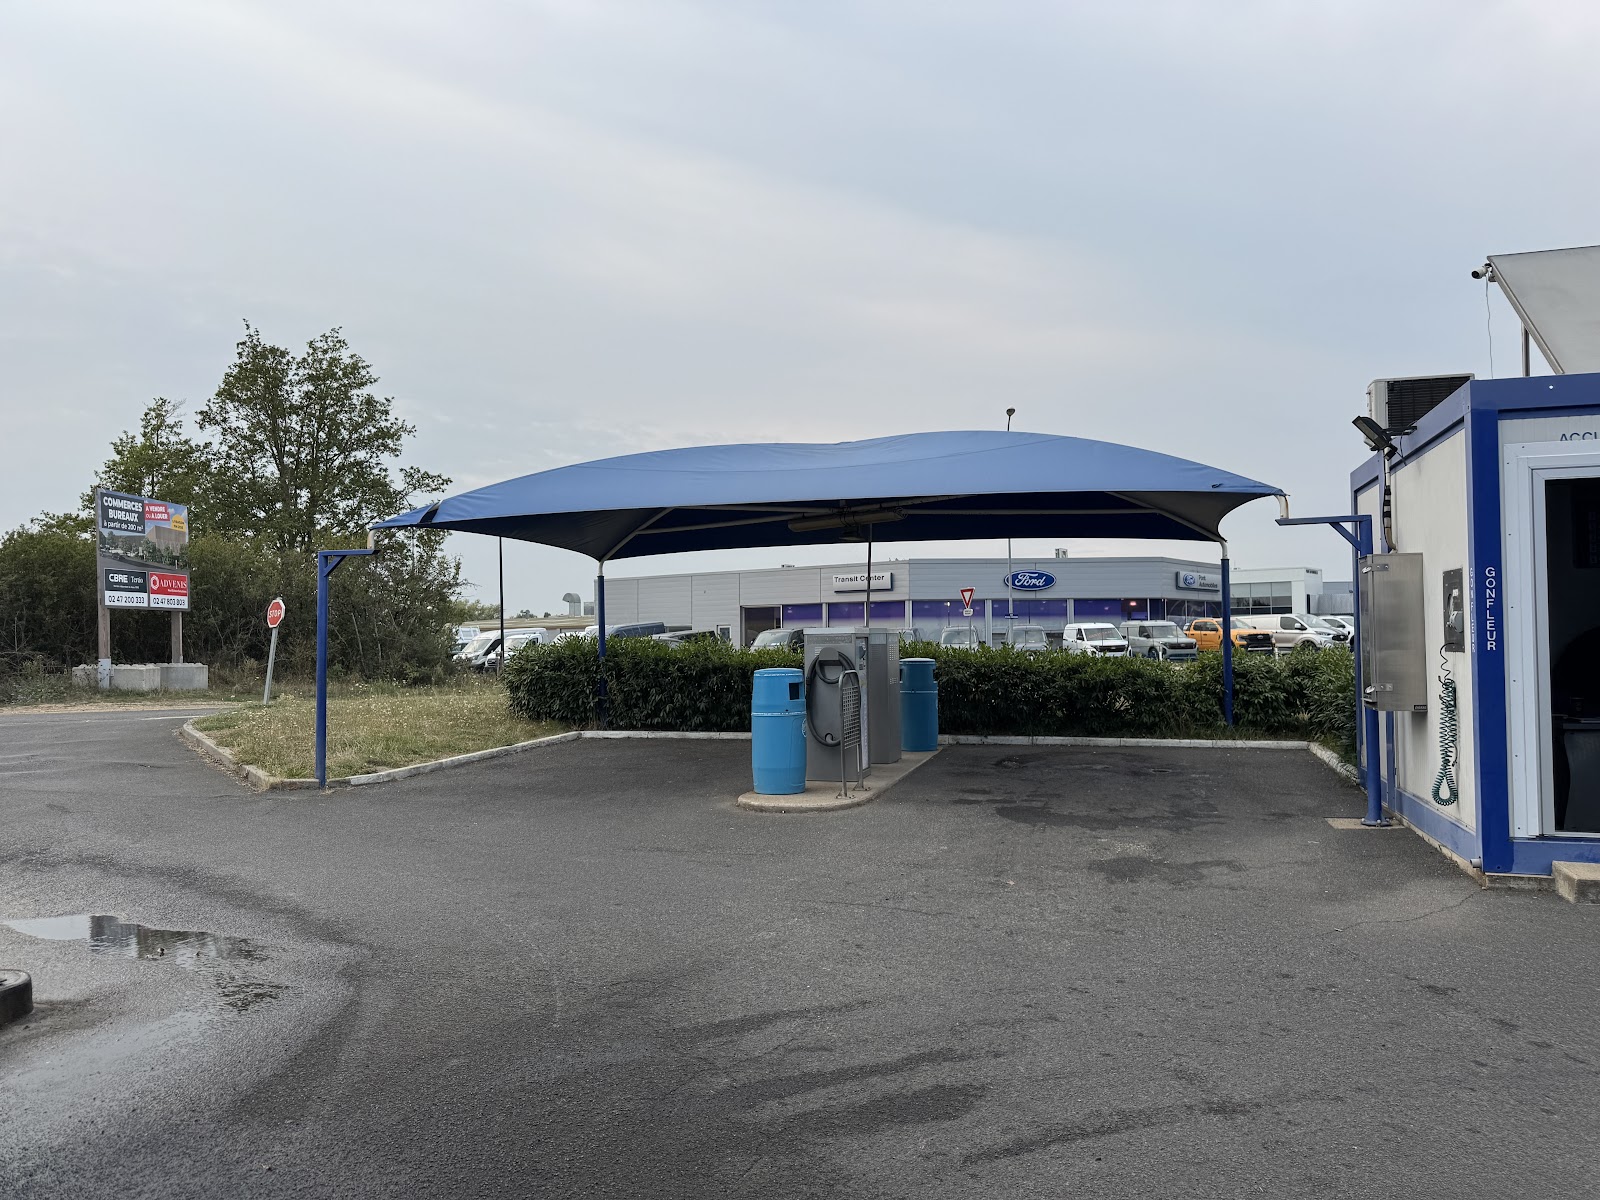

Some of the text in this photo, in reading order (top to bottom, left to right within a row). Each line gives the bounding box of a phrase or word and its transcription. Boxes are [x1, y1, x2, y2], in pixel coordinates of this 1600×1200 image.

[103, 496, 143, 512] COMMERCES
[108, 508, 139, 522] BUREAUX
[108, 521, 121, 529] partir
[108, 573, 129, 583] CBRE
[834, 575, 858, 583] Transit
[1015, 572, 1046, 586] Ford
[160, 579, 188, 589] ADVENIS
[108, 595, 116, 603] 02
[116, 595, 123, 603] 47
[135, 596, 145, 604] 333
[153, 597, 160, 605] 02
[269, 609, 282, 618] STOP
[1485, 566, 1496, 651] GONFLEUR
